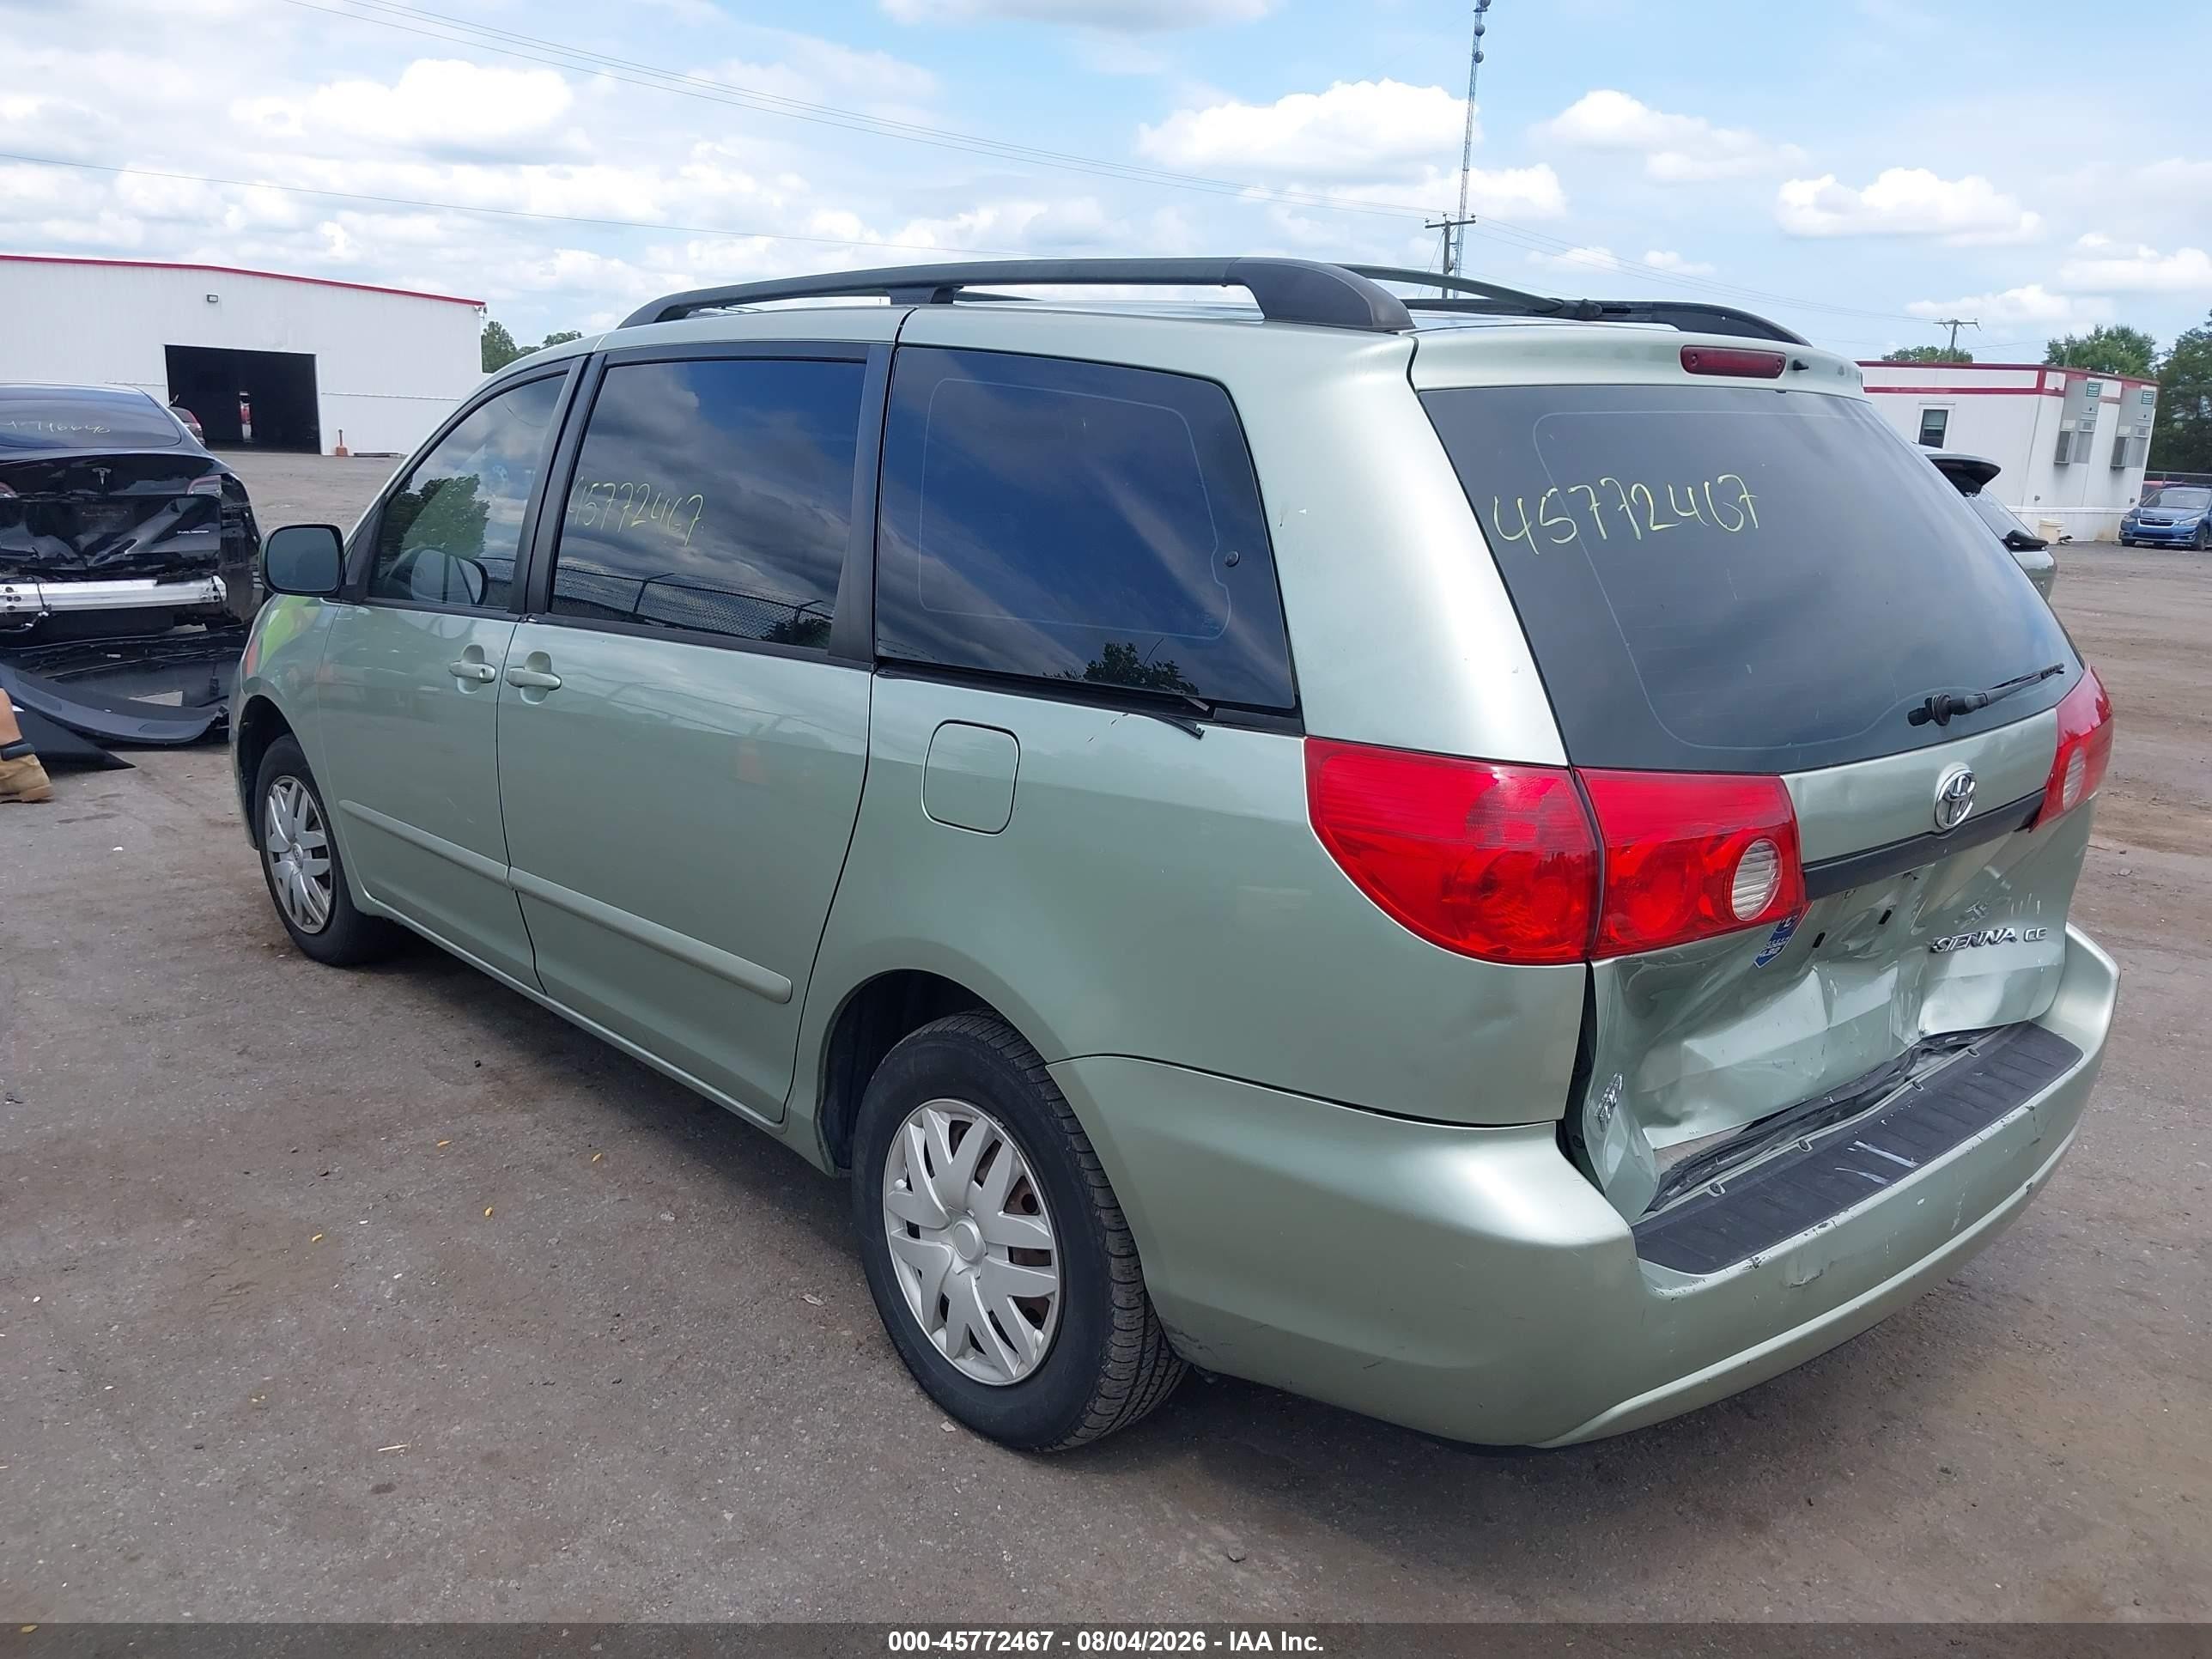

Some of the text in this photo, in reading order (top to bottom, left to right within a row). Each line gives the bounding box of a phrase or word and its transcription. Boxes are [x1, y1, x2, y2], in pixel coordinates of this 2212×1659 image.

[567, 475, 704, 547] 45772467
[1492, 474, 1759, 556] 45772467
[1929, 927, 2018, 954] SIENNA
